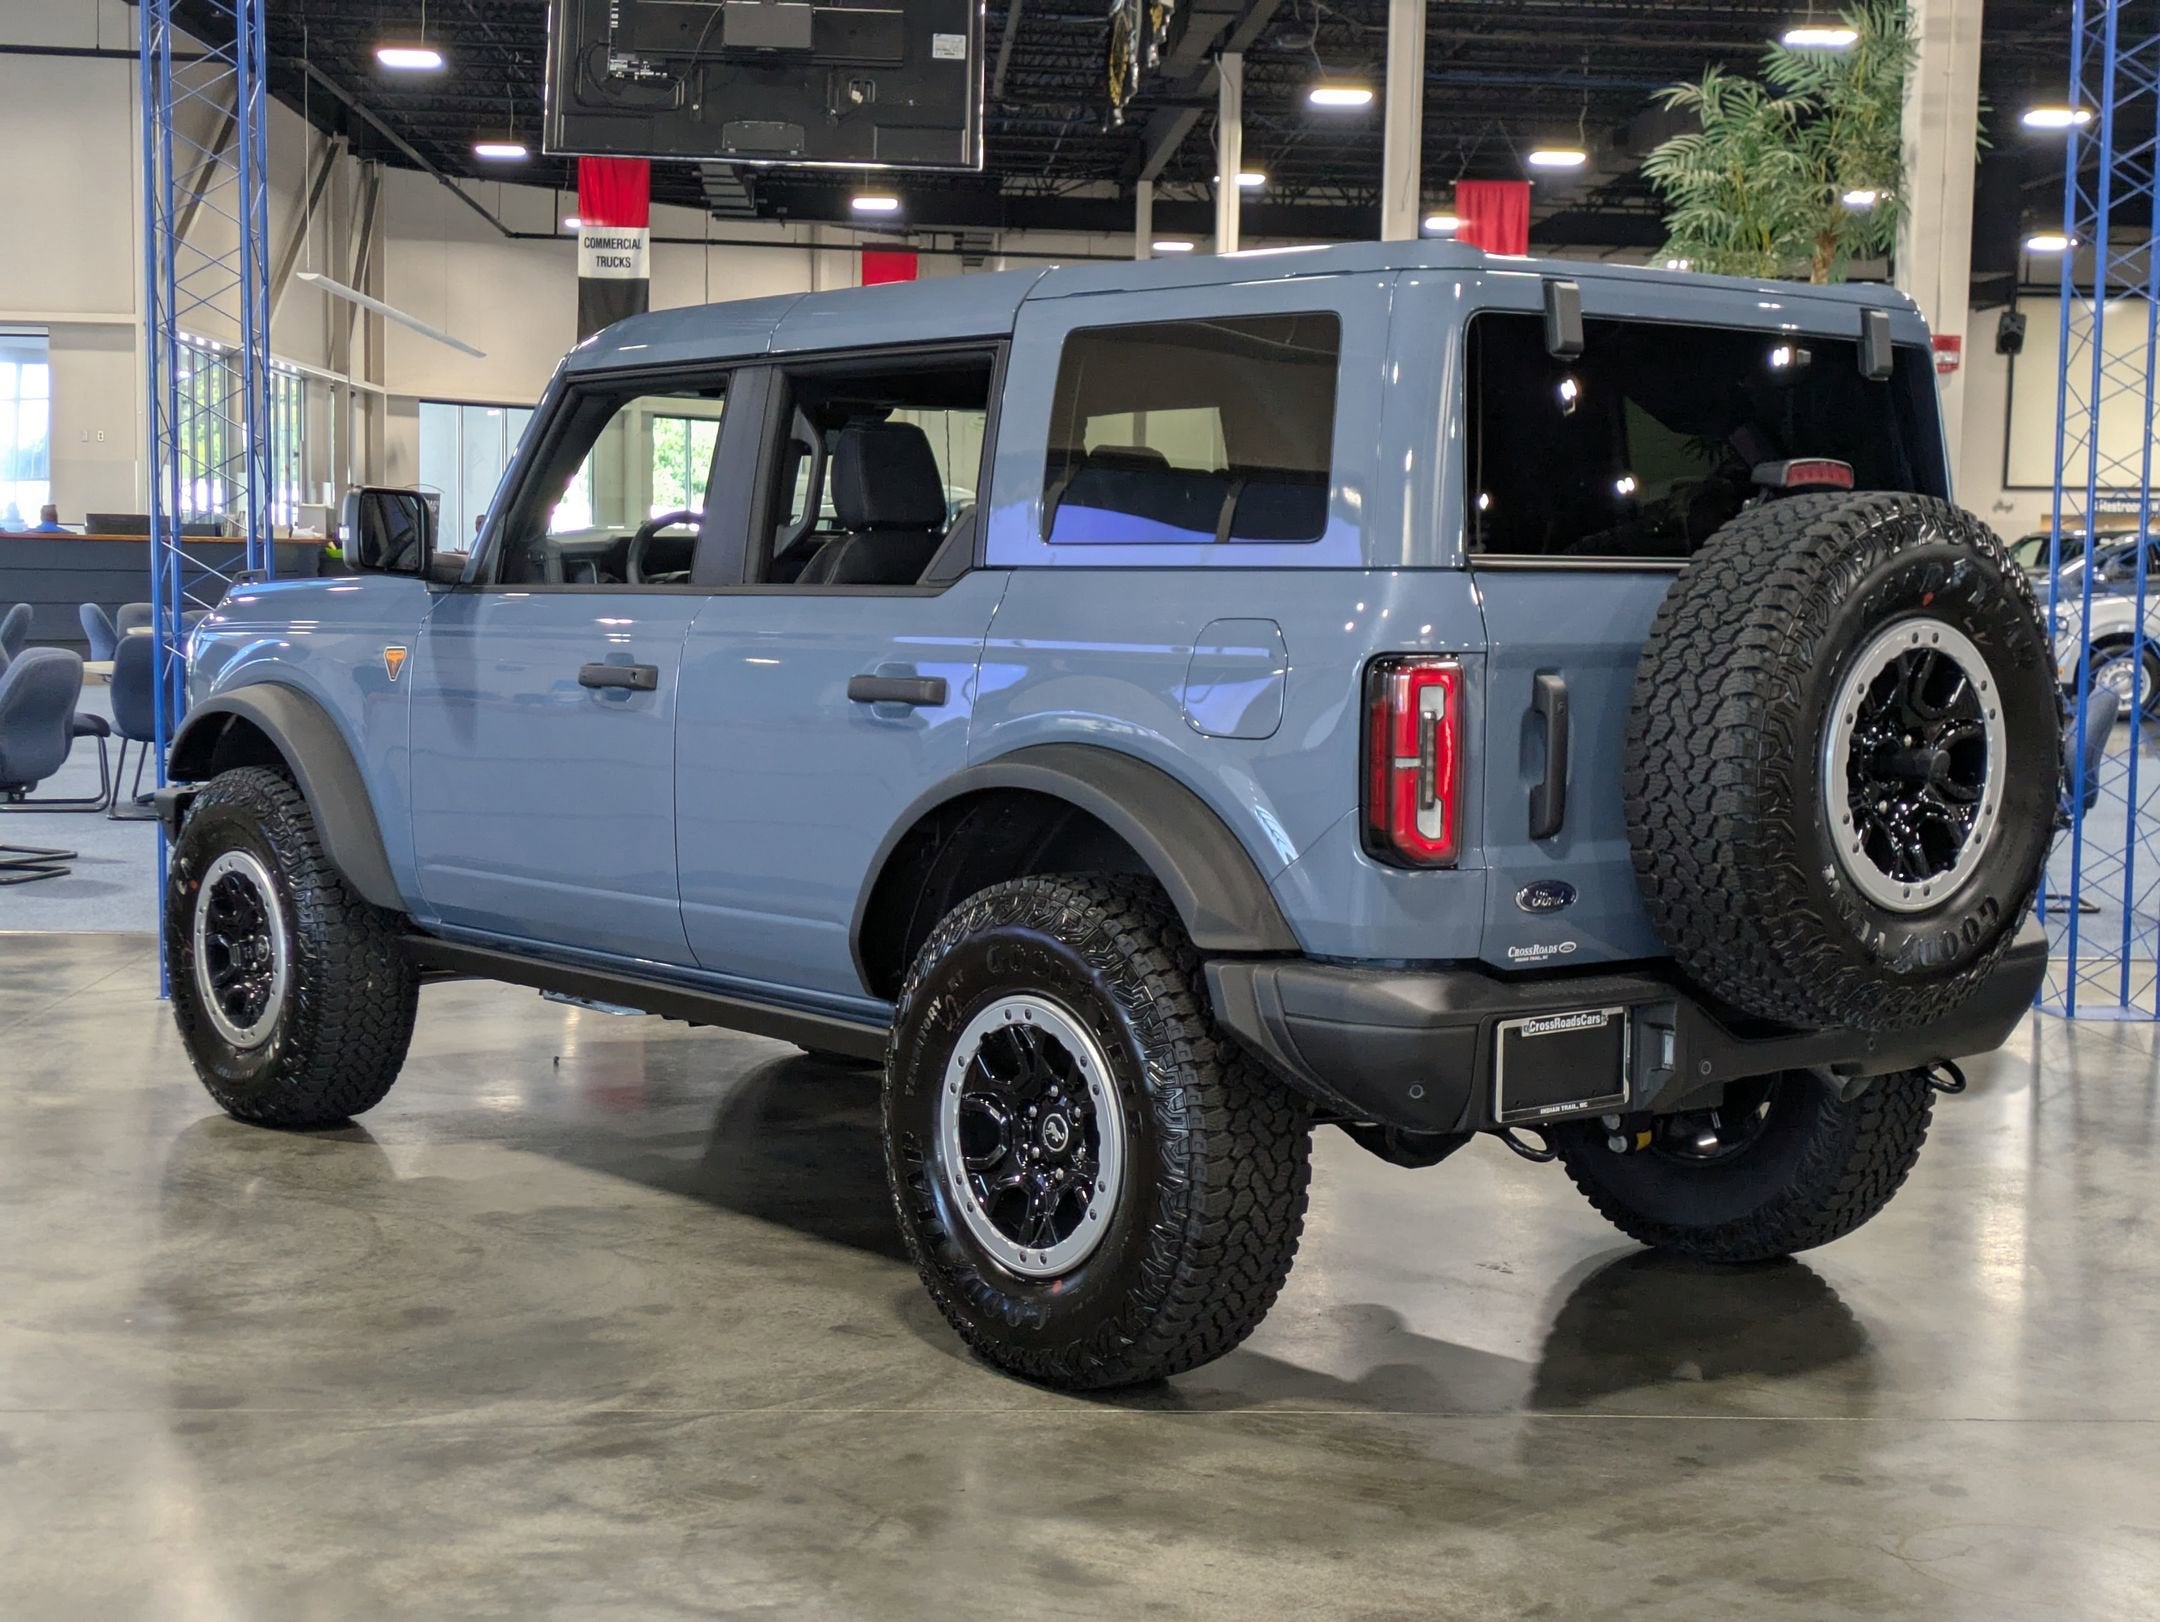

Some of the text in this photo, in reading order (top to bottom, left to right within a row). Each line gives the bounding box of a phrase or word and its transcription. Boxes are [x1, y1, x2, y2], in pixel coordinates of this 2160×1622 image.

[584, 237, 642, 249] COMMERCIAL
[596, 255, 631, 268] TRUCKS
[1529, 1013, 1601, 1033] CrossRoadsCars
[903, 995, 943, 1096] TERRITORY
